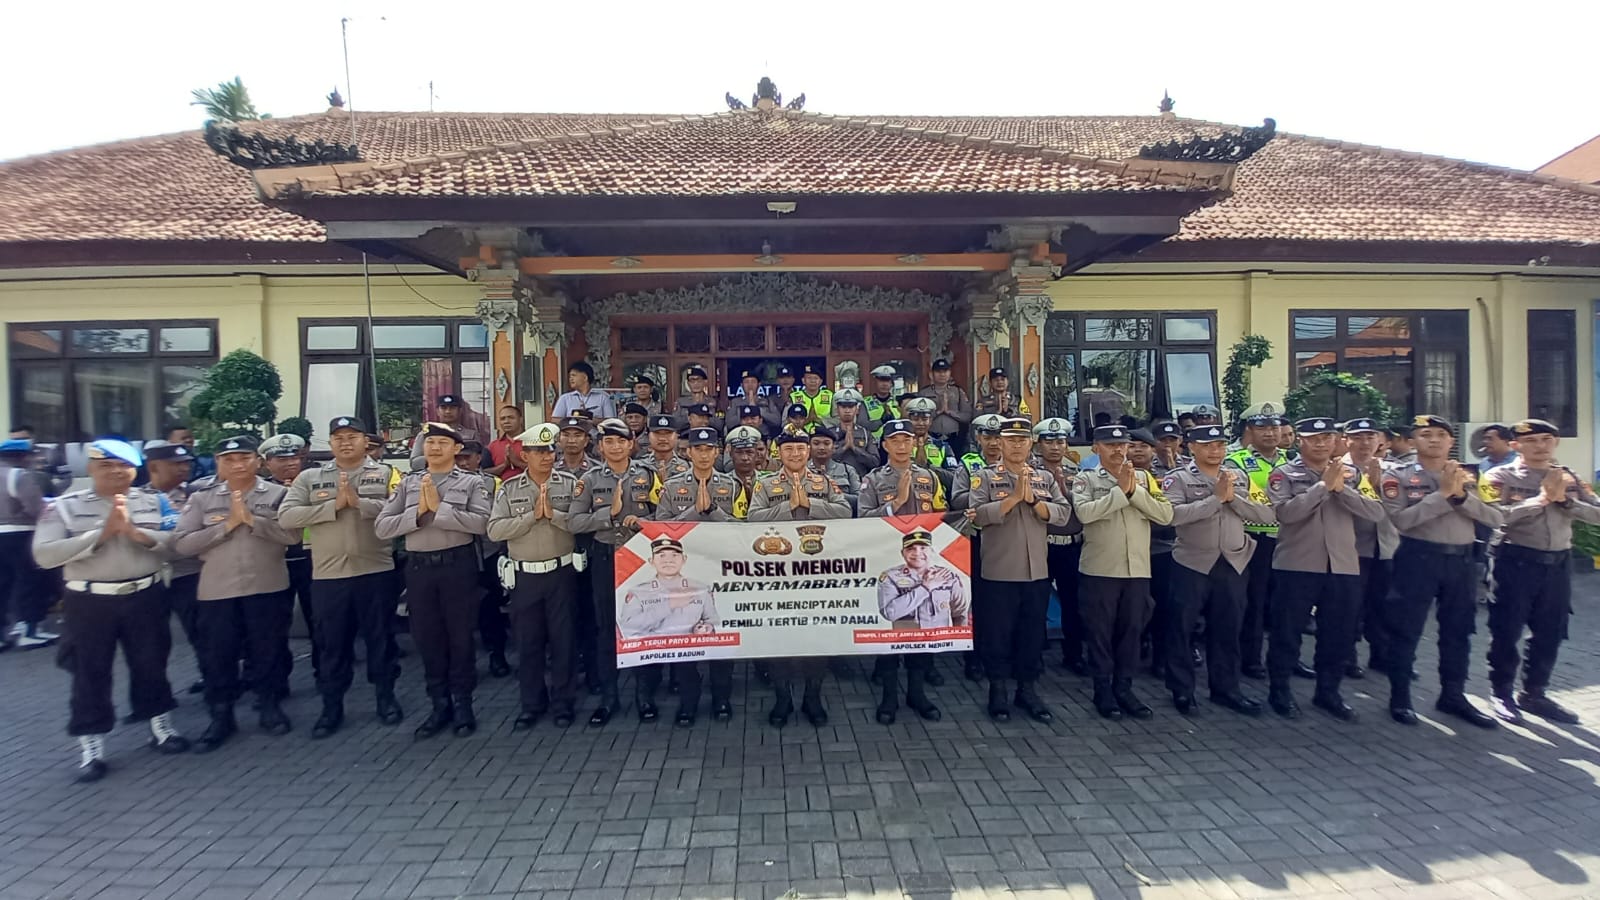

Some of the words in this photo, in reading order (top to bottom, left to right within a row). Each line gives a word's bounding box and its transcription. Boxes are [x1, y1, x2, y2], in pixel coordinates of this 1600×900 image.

[720, 559, 787, 577] POLSEK
[792, 557, 866, 575] MENGWI
[711, 577, 878, 593] MENYAMABRAYA
[735, 601, 773, 612] UNTUK
[777, 599, 861, 611] MENCIPTAKAN
[722, 618, 763, 628] PEMILU
[767, 616, 809, 627] TERTIB
[812, 616, 837, 625] DAN
[840, 614, 879, 625] DAMAI
